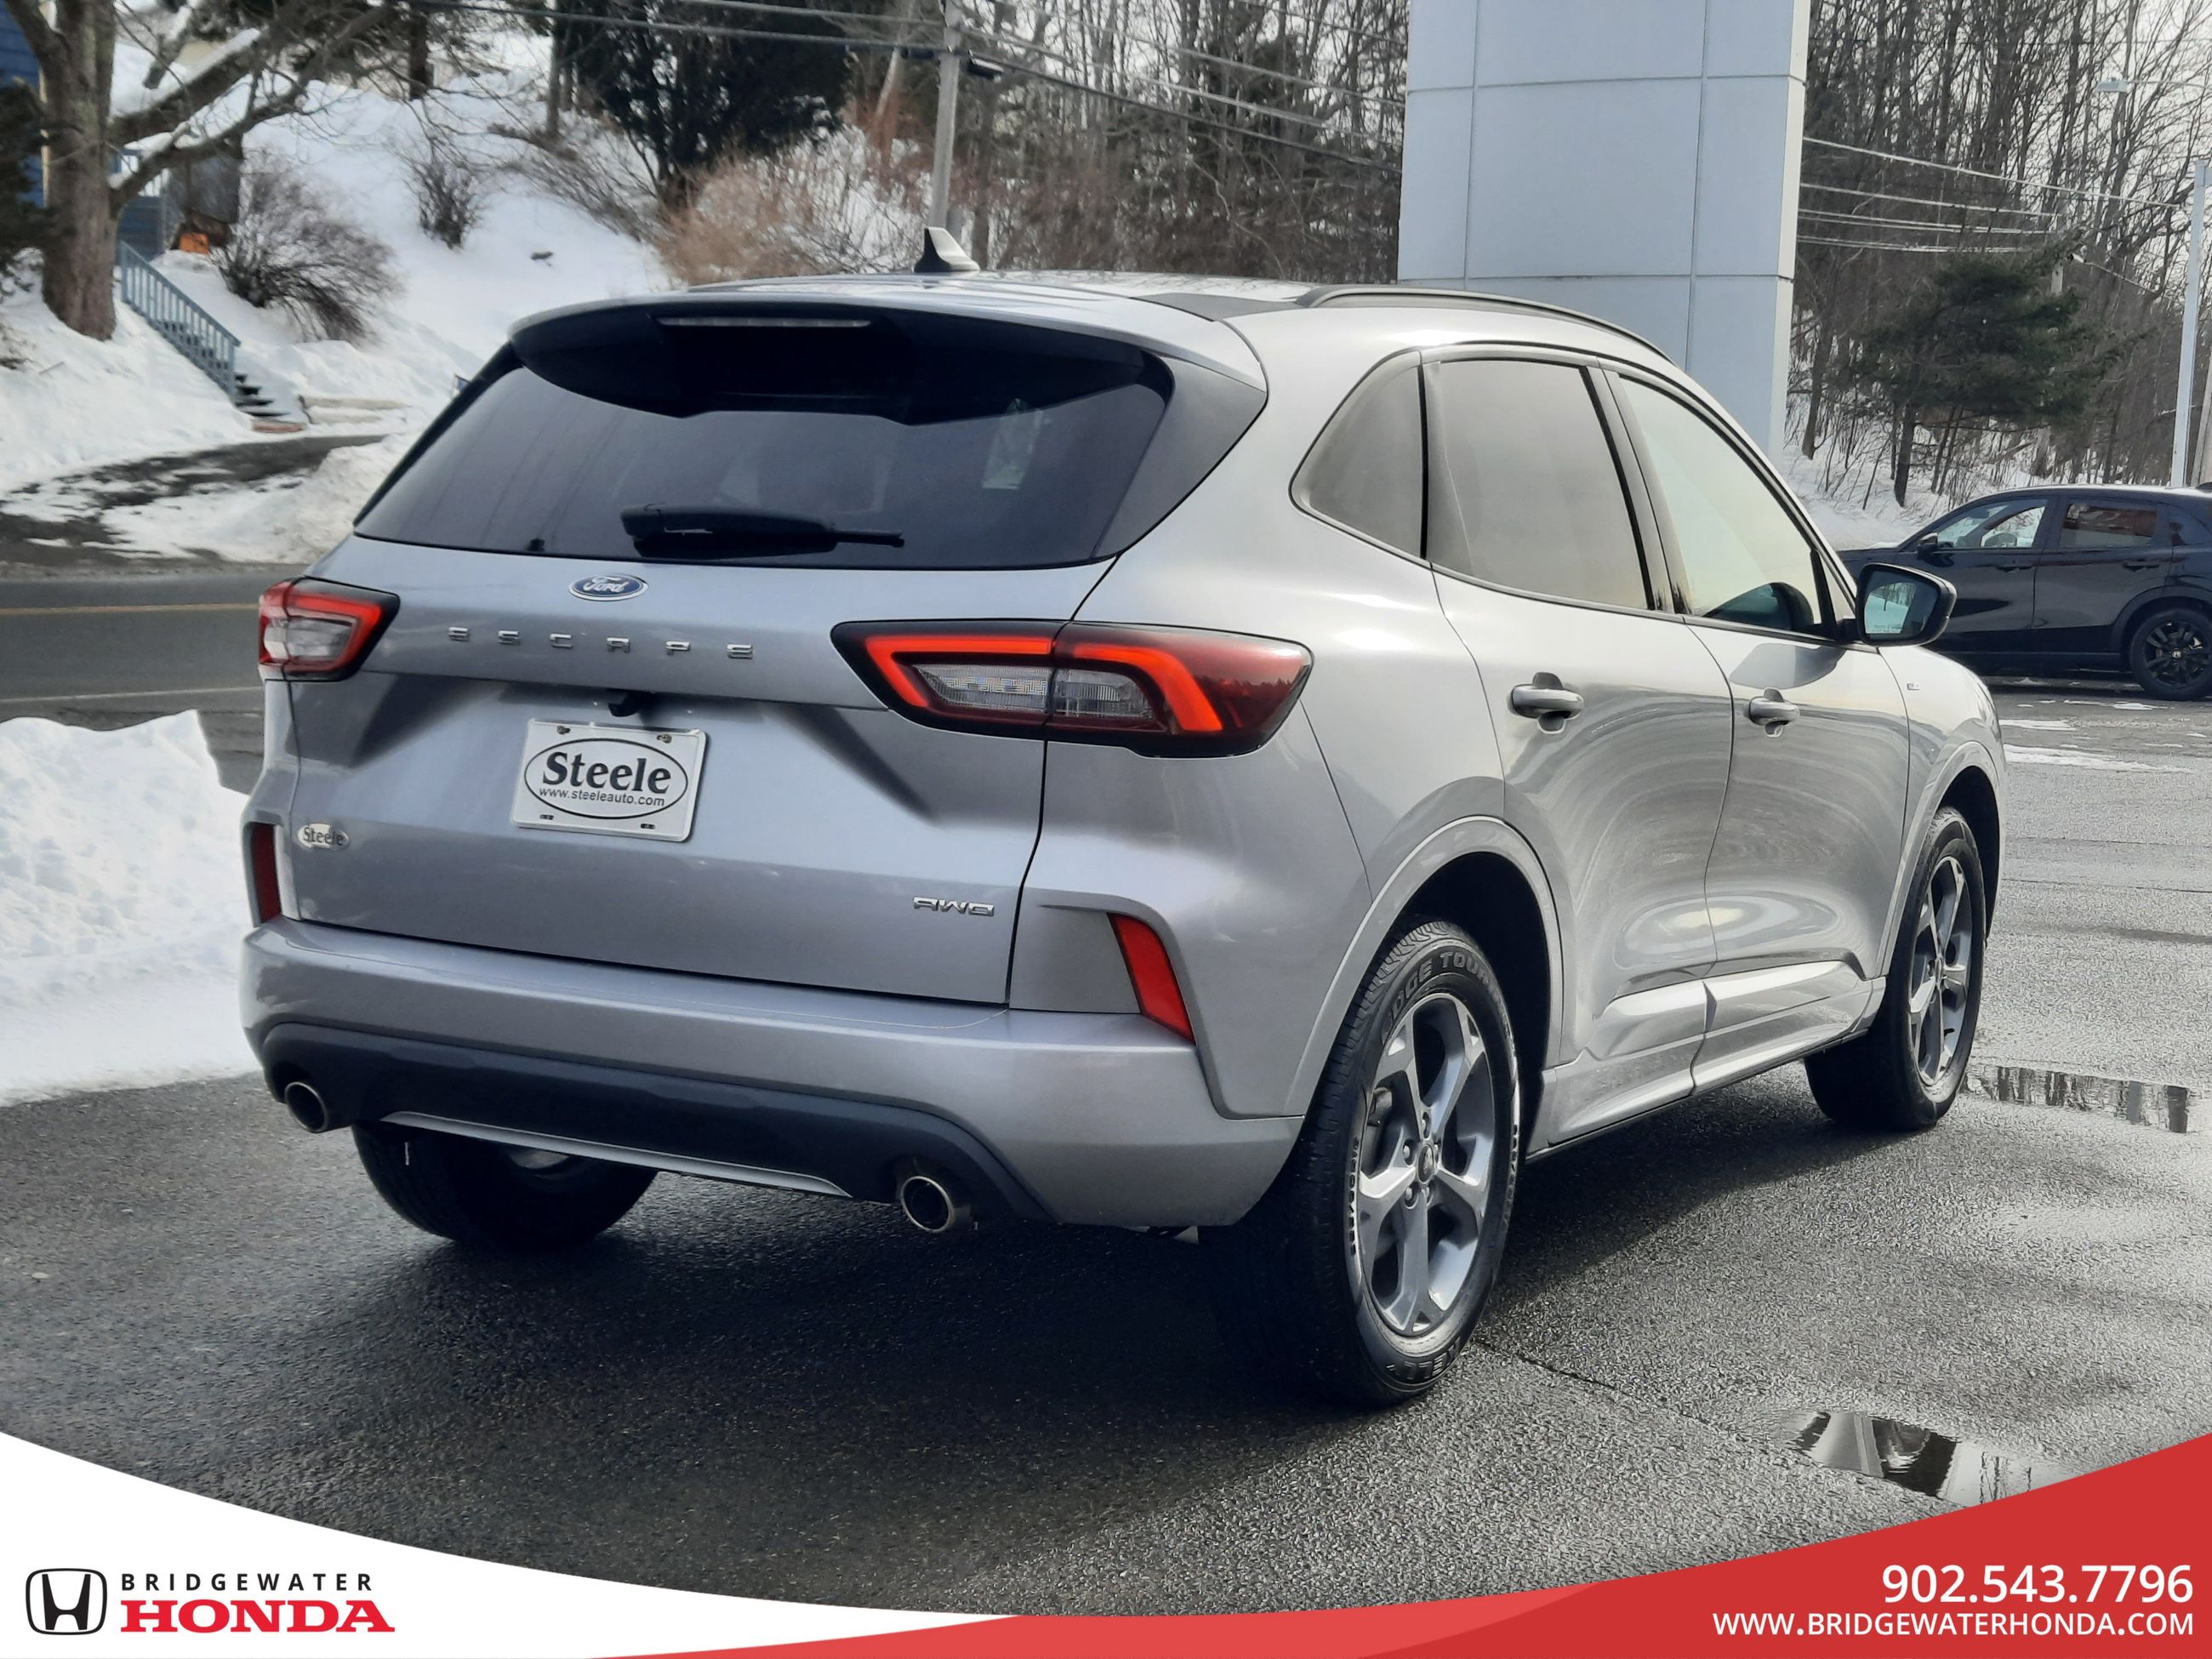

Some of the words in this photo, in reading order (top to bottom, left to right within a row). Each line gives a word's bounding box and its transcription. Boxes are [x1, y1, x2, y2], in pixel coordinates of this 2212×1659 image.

[583, 576, 629, 593] Ford
[448, 626, 754, 658] ESCAPE
[542, 751, 671, 794] Steele
[539, 787, 664, 807] www.steeleauto.com
[303, 826, 345, 846] Steele
[913, 896, 995, 917] AWD
